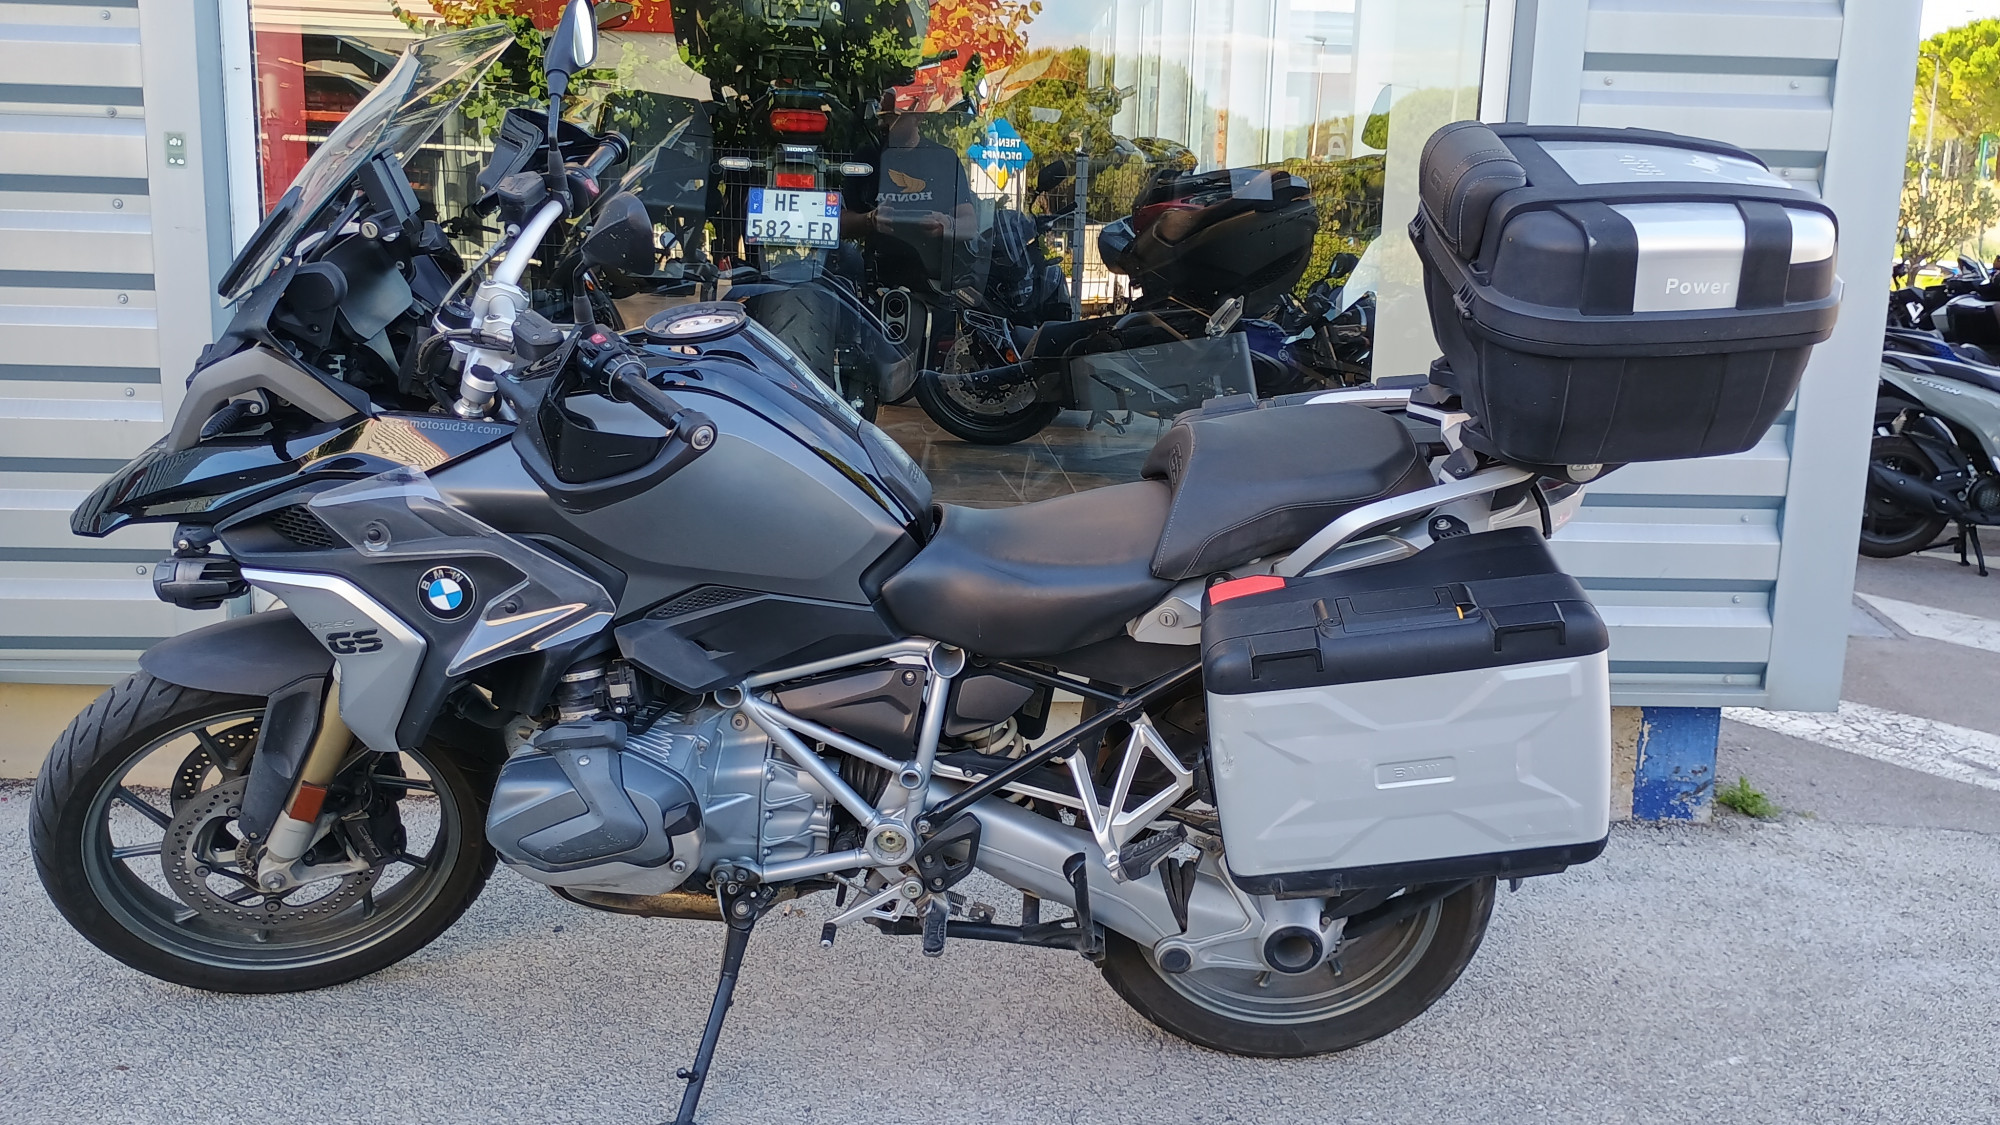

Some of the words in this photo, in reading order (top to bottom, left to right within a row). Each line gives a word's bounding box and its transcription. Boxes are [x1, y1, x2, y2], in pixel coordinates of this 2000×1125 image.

[774, 193, 800, 212] HE
[826, 206, 838, 216] 34
[1665, 278, 1731, 295] Power
[420, 569, 464, 591] BMW
[326, 628, 384, 655] GS
